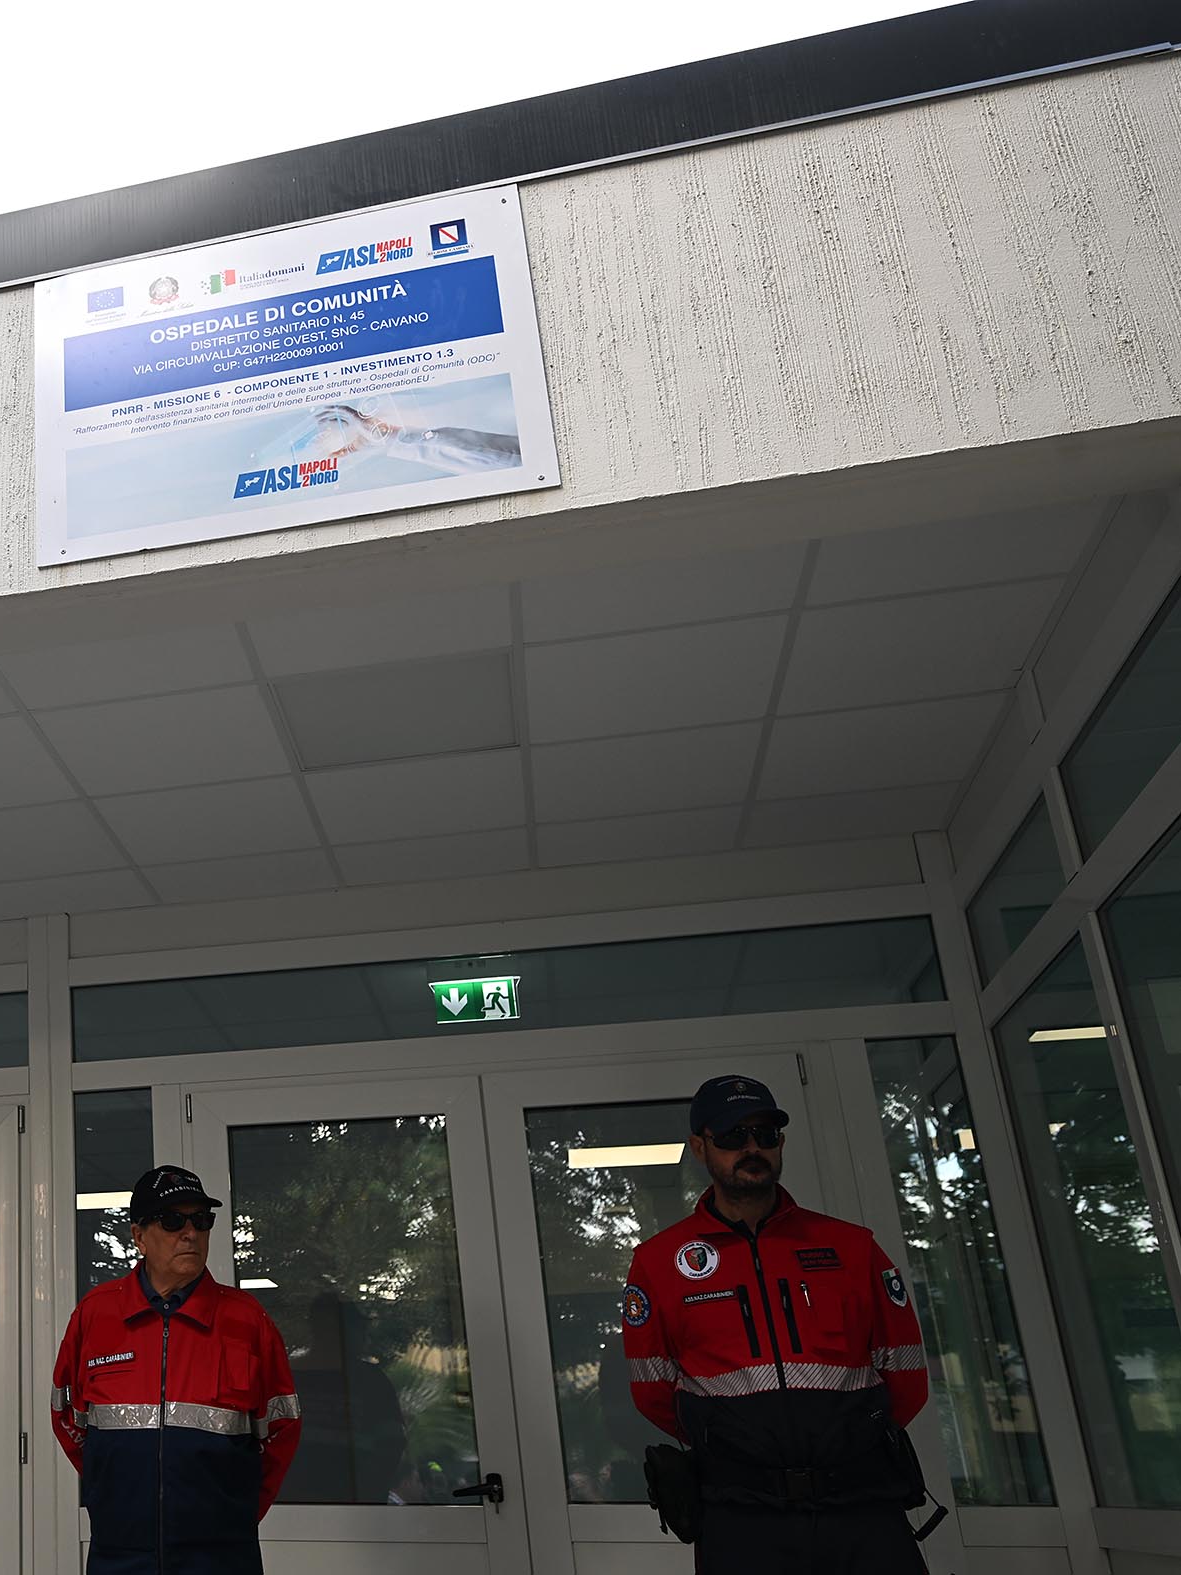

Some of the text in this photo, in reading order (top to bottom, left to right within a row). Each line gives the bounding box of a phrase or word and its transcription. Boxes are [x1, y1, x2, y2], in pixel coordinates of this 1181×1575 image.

[343, 243, 379, 270] ASL
[376, 237, 412, 252] NAPOLI
[150, 311, 258, 344] OSPEDALE
[265, 305, 285, 322] DI
[292, 279, 407, 317] COMUNITÀ
[191, 310, 365, 351] DISTRETTO SANITARIO N. 45
[133, 365, 152, 375] VIA
[156, 340, 280, 371] CIRCUMVALLAZIONE
[284, 331, 328, 347] OVEST,
[332, 325, 359, 338] SNC
[370, 312, 429, 331] CAIVANO
[213, 342, 344, 373] CUP: G47H22000910001
[112, 405, 143, 417] PNRR
[153, 392, 210, 410] MISSIONE
[234, 372, 319, 394] COMPONENTE
[324, 371, 329, 379] 1
[341, 352, 432, 376] INVESTIMENTO
[438, 349, 454, 359] 1.3
[195, 401, 229, 413] sanitaria
[231, 393, 276, 407] intermedia
[286, 387, 306, 396] delle
[309, 384, 324, 392] sue
[327, 377, 361, 389] strutture
[370, 368, 409, 383] Ospedali
[411, 366, 420, 374] di
[422, 359, 464, 372] Comunità
[131, 420, 170, 434] Intervento
[173, 413, 211, 426] finanziato
[214, 411, 229, 419] con
[232, 405, 253, 416] fondi
[305, 391, 341, 403] Europea
[349, 376, 430, 395] NextGenerationEU
[264, 464, 301, 494] ASL
[299, 458, 337, 475] NAPOLI
